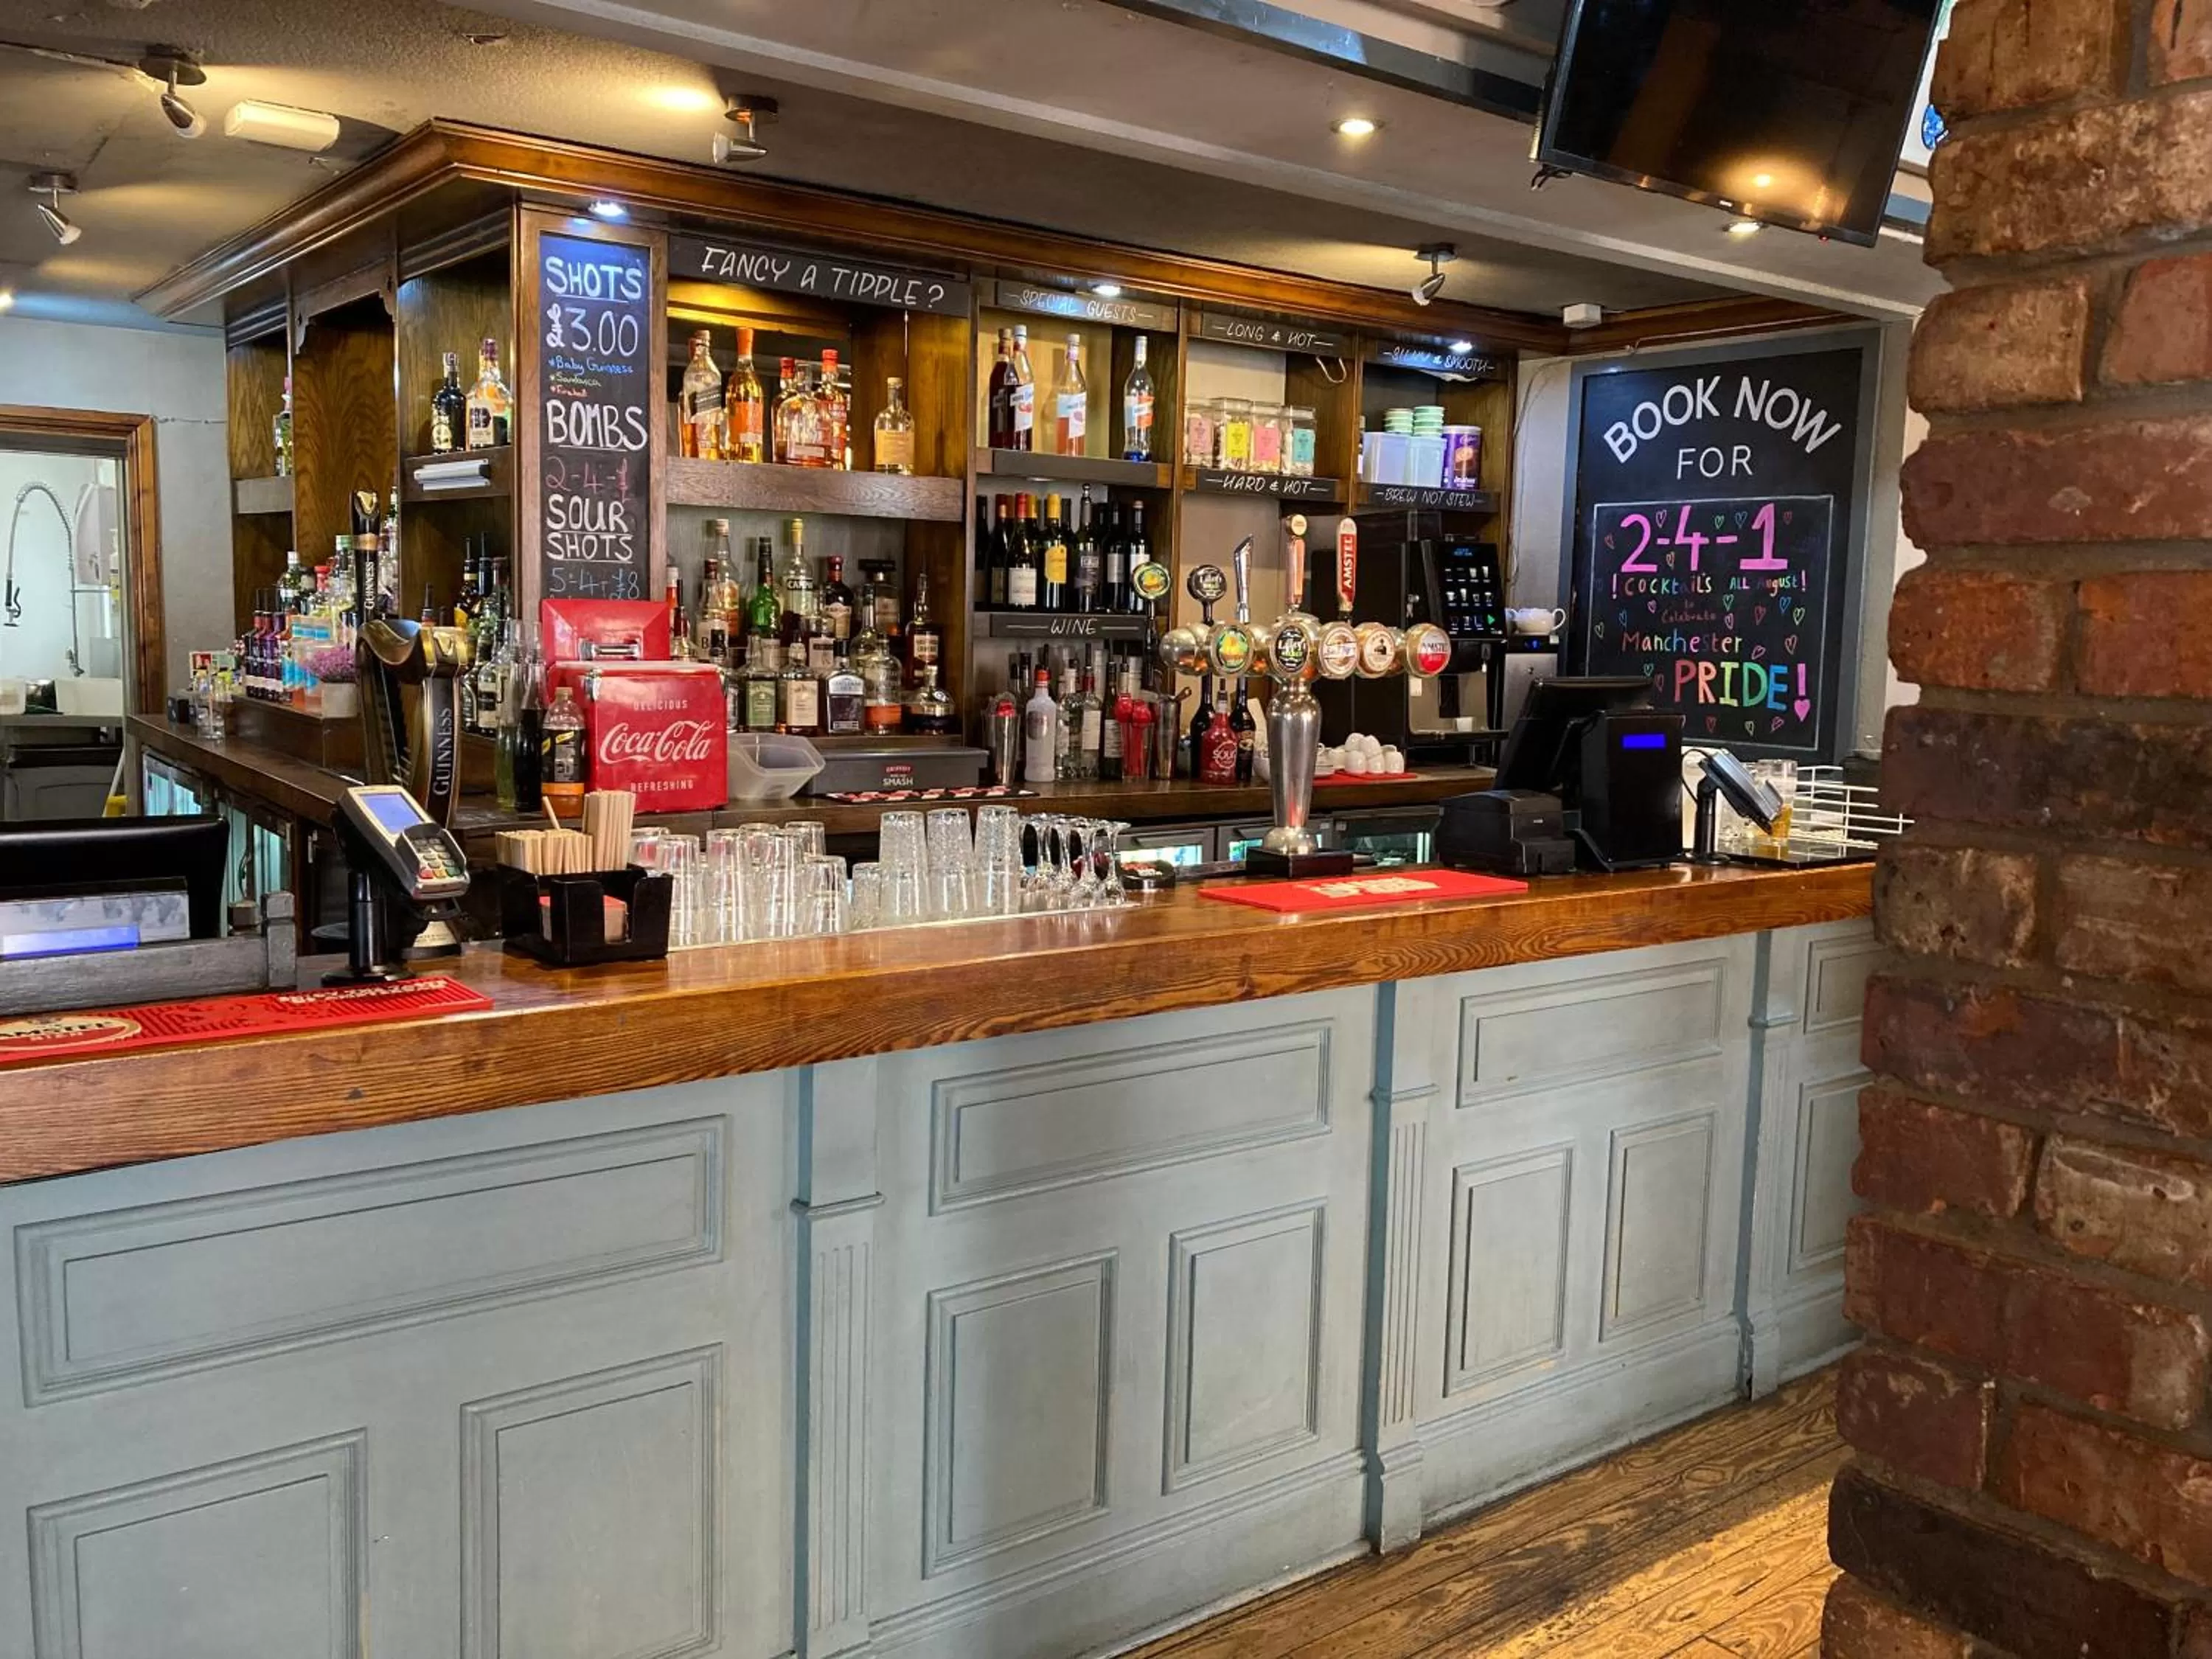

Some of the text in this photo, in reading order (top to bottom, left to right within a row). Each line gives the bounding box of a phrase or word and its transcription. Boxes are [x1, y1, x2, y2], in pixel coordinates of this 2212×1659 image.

[545, 256, 643, 301] SHOTS
[701, 246, 945, 308] FANCY A TIPPLE?
[1086, 300, 1136, 323] GUESTS
[546, 303, 639, 357] £3.00
[1226, 322, 1265, 342] LONG
[1287, 332, 1315, 348] HOT
[1444, 355, 1488, 372] SMOOTH
[546, 399, 647, 451] BOMBS
[1603, 375, 1842, 464] BOOK NOW
[1677, 445, 1753, 480] FOR
[1222, 475, 1265, 492] HARD
[1283, 479, 1312, 495] HOT
[1385, 487, 1475, 507] BREW NOT STEW
[546, 494, 629, 532] SOUR
[546, 532, 633, 562] SHOTS
[1620, 503, 1789, 573] 2-4-1
[1343, 536, 1353, 589] AMSTEL
[364, 561, 374, 610] GUINNESS
[1050, 618, 1098, 635] WINE
[1622, 627, 1743, 654] Manchester
[633, 700, 689, 712] DELICIOUS
[433, 707, 453, 796] GUINNESS
[599, 720, 716, 765] Coca-Cola
[630, 779, 694, 793] REFRESHING
